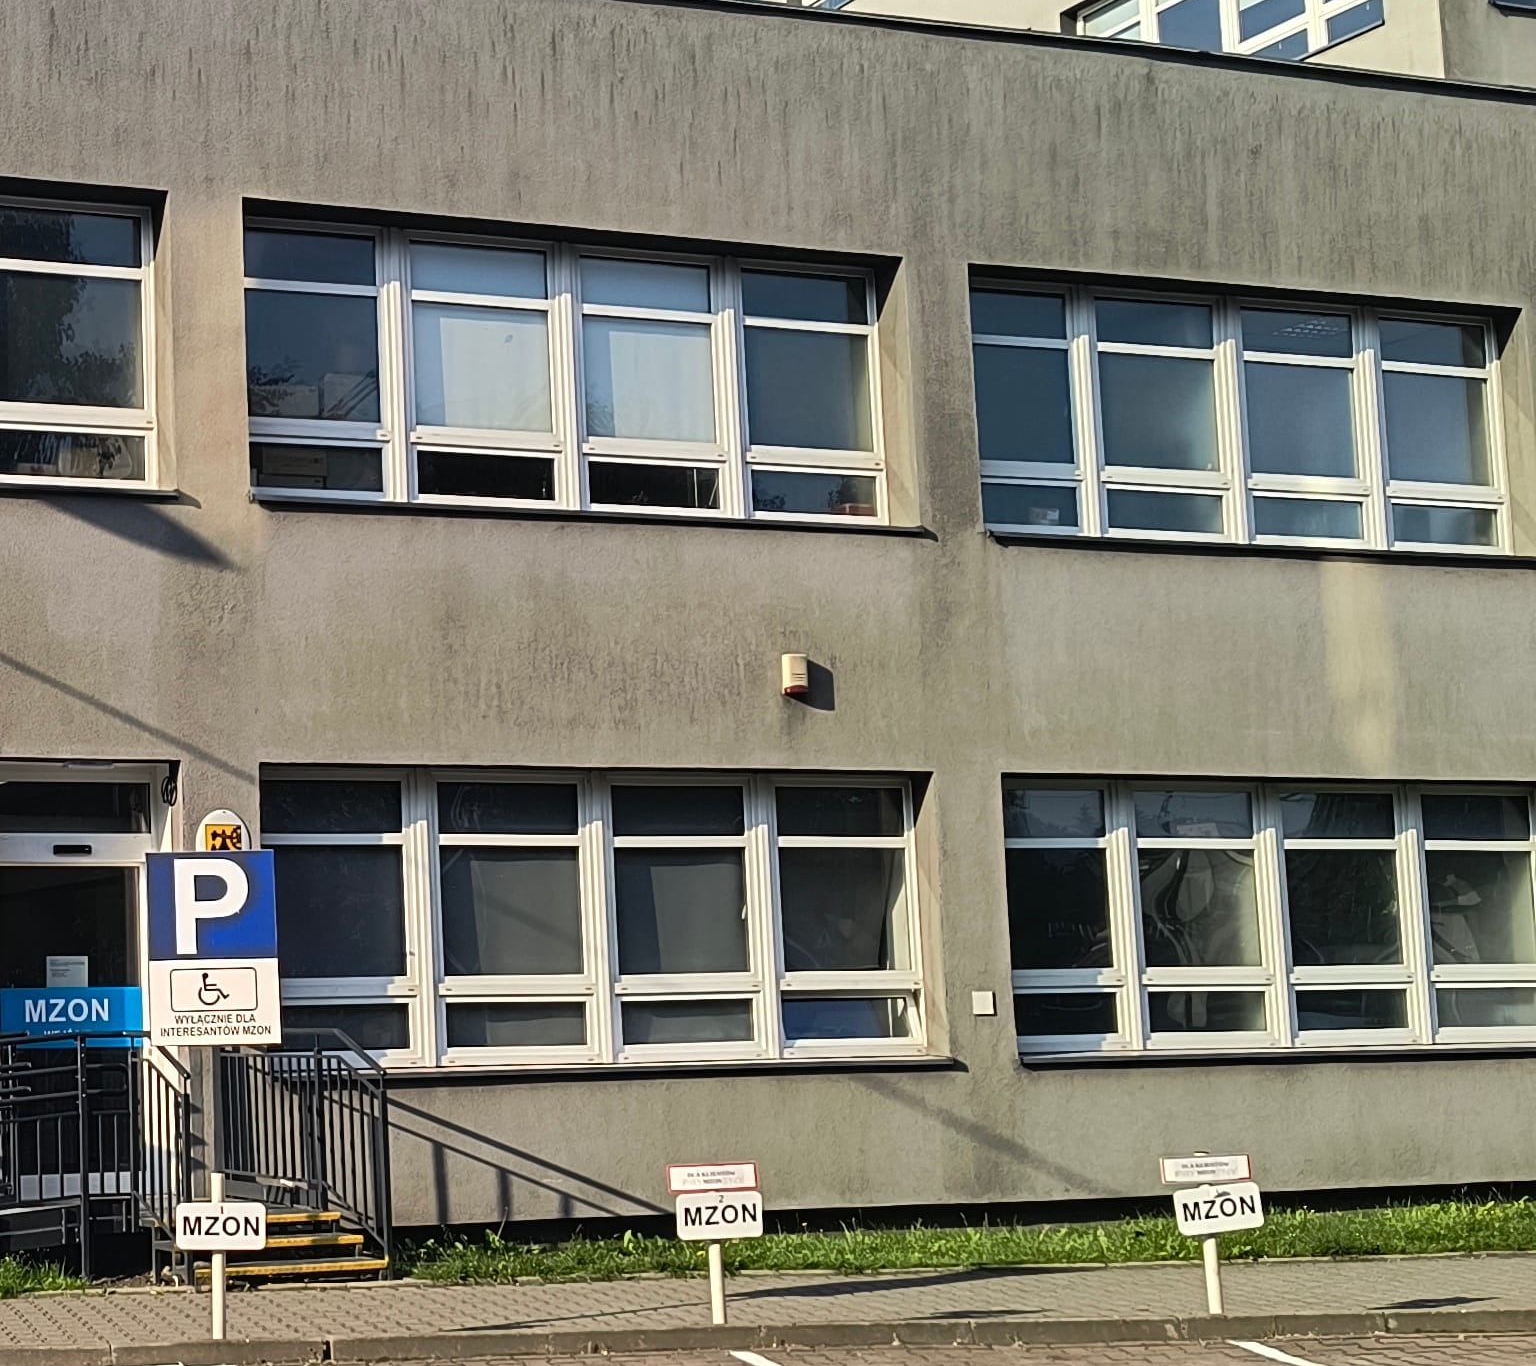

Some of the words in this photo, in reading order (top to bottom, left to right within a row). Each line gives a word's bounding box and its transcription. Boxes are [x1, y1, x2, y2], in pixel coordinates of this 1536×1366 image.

[173, 858, 249, 955] P
[24, 998, 109, 1023] MZON
[174, 1013, 233, 1026] WYŁĄCZNIE
[235, 1013, 256, 1024] DLA
[160, 1026, 240, 1037] INTERESANTÓW
[242, 1025, 272, 1036] MZON
[718, 1195, 725, 1204] 2
[1182, 1194, 1256, 1223] MZON
[182, 1216, 260, 1236] MZON
[684, 1203, 757, 1227] MZON
